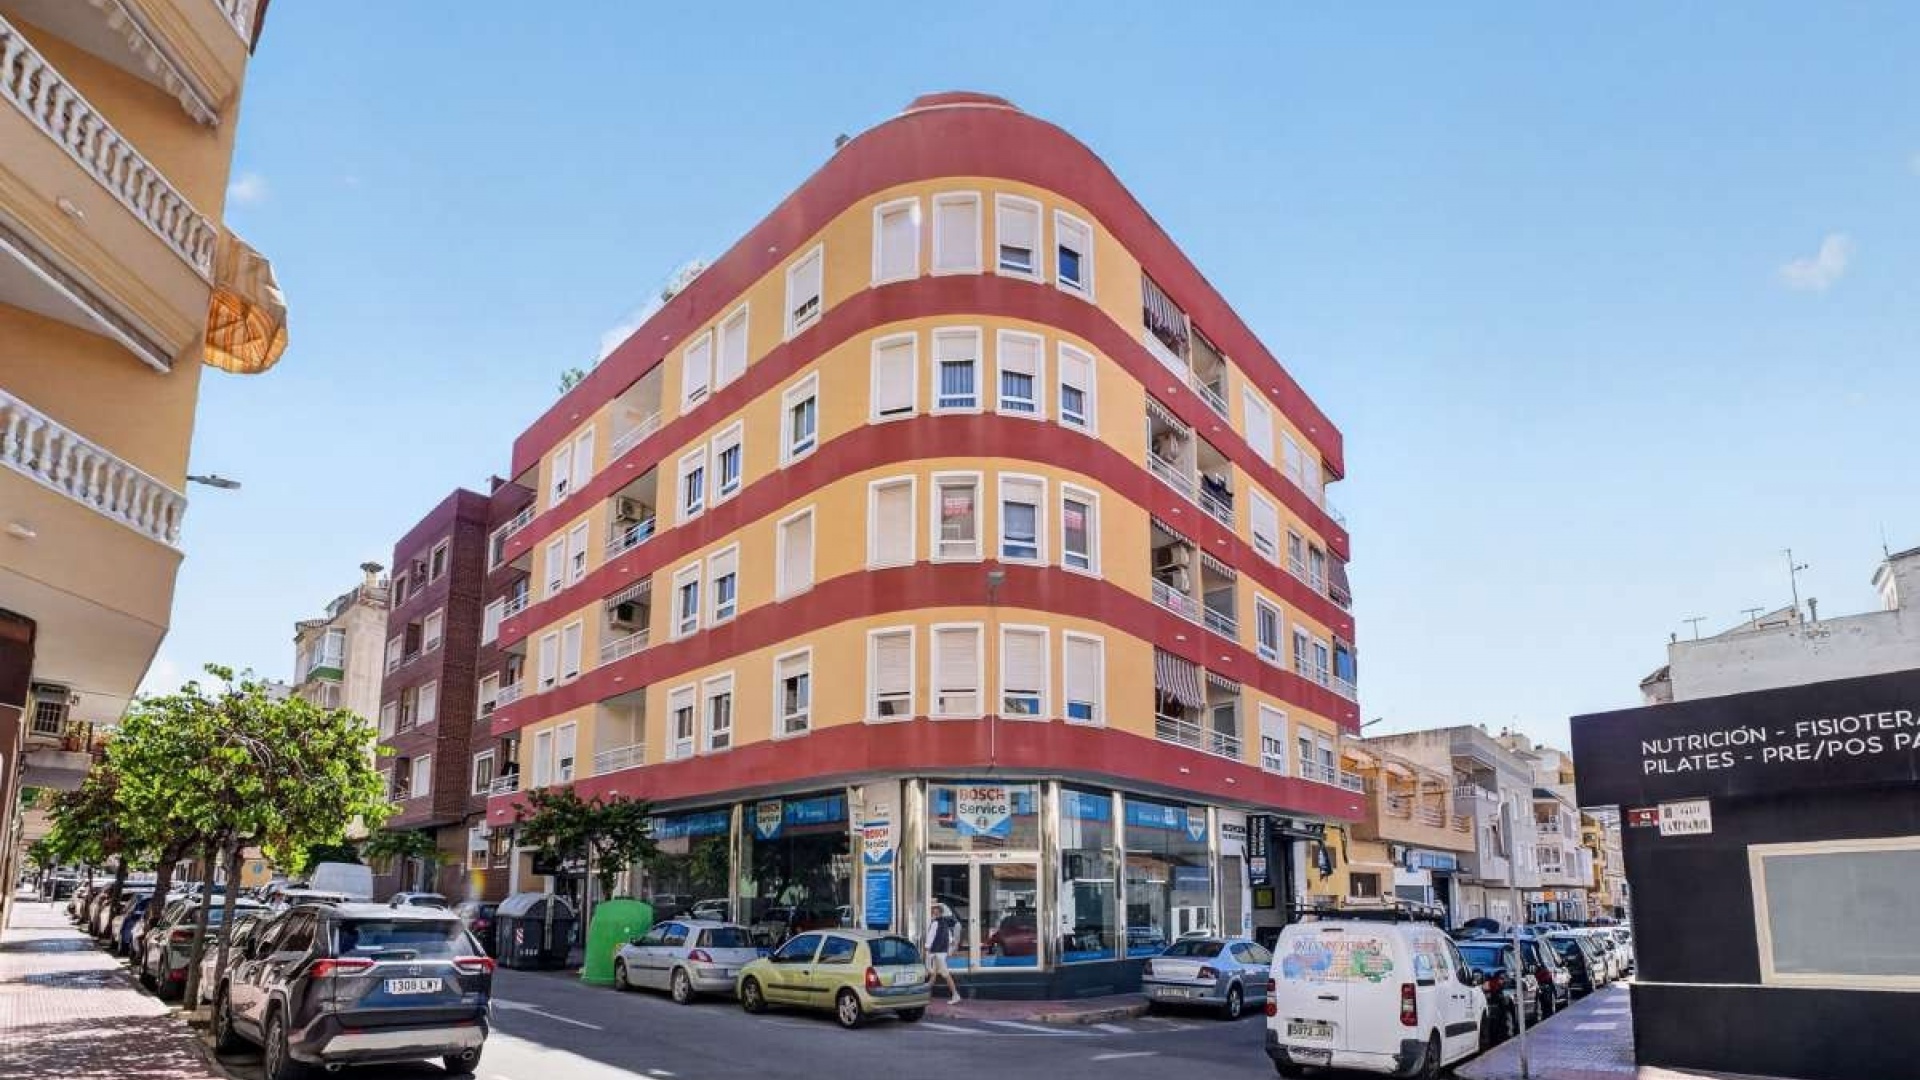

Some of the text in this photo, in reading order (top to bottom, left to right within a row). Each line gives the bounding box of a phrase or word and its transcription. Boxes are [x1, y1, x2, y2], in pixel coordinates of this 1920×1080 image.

[1642, 725, 1766, 756] NUTRICIÓN
[1795, 710, 1920, 738] FISIOTER
[1644, 752, 1735, 776] PILATES
[1763, 736, 1884, 764] PRE/POS
[960, 787, 1006, 801] BOSCH
[960, 802, 1007, 815] Service
